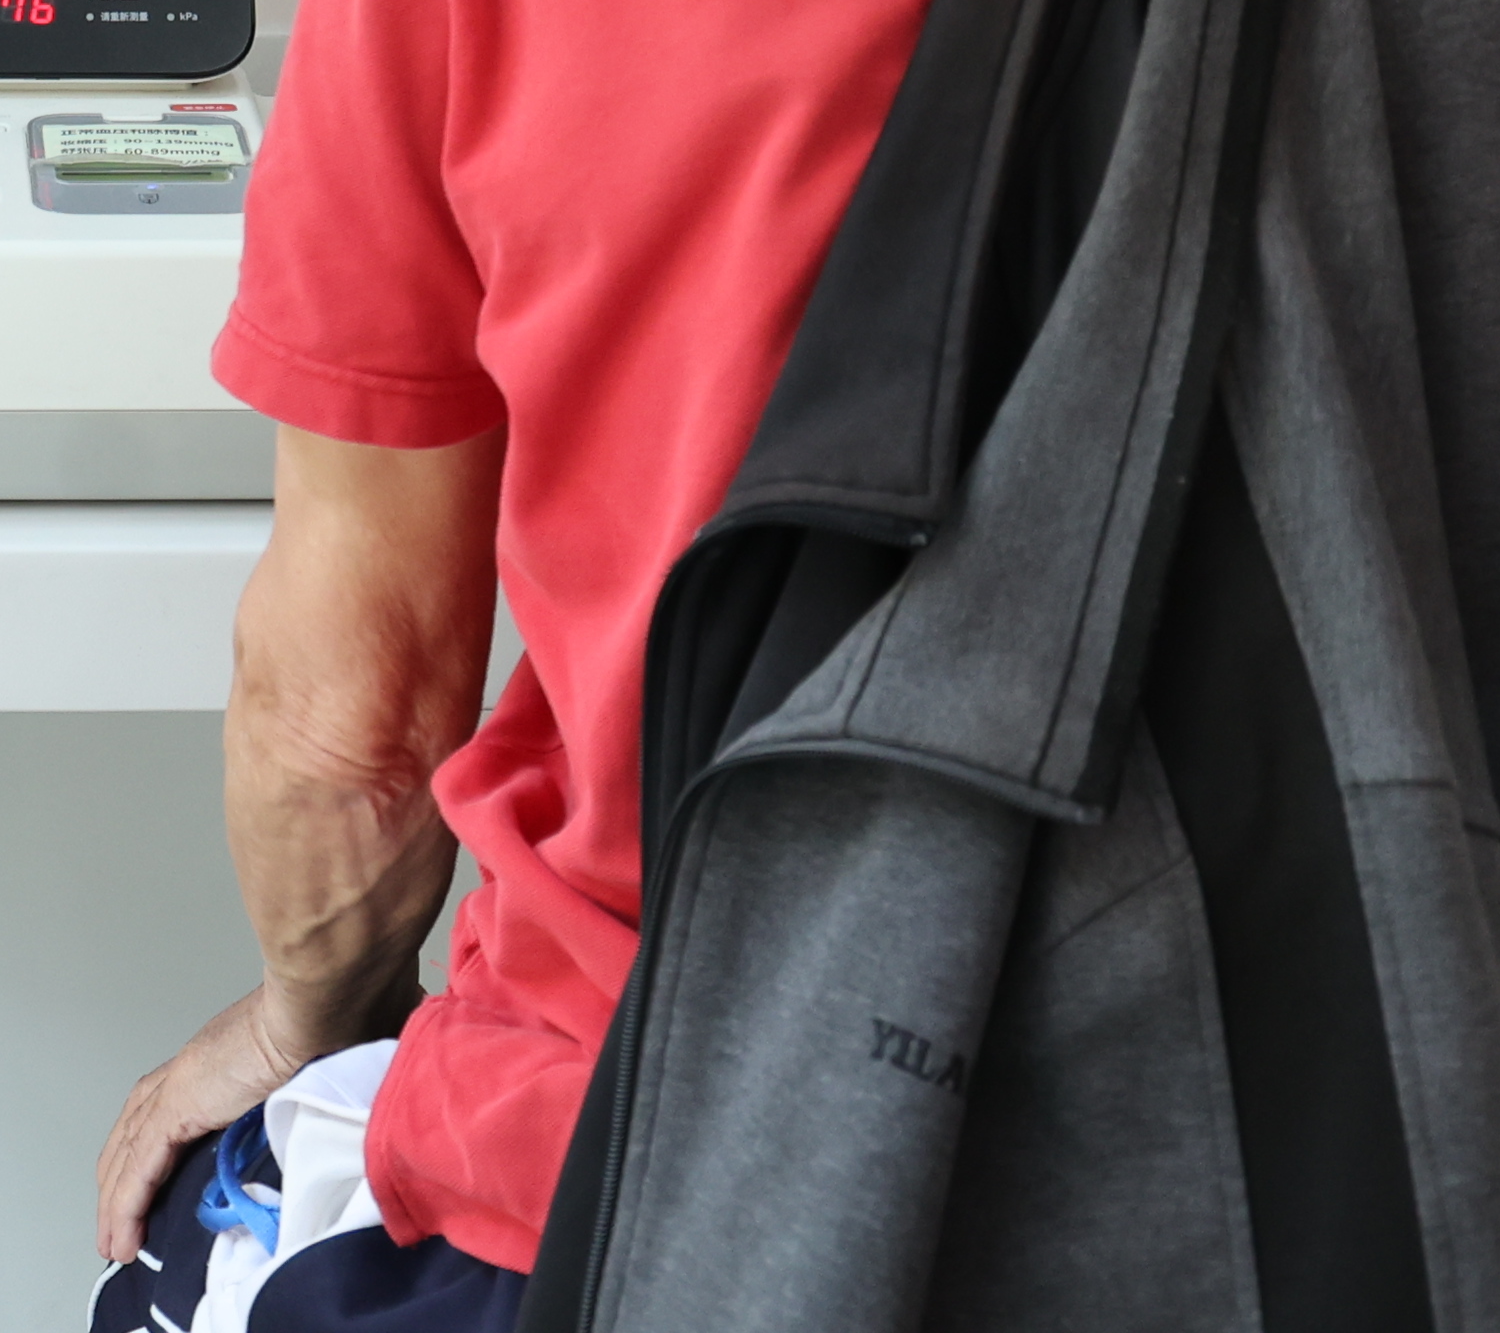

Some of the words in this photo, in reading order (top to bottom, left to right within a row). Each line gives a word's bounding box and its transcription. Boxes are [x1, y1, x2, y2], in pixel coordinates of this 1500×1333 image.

[100, 11, 148, 23] 请重新测量
[179, 11, 198, 22] kPa
